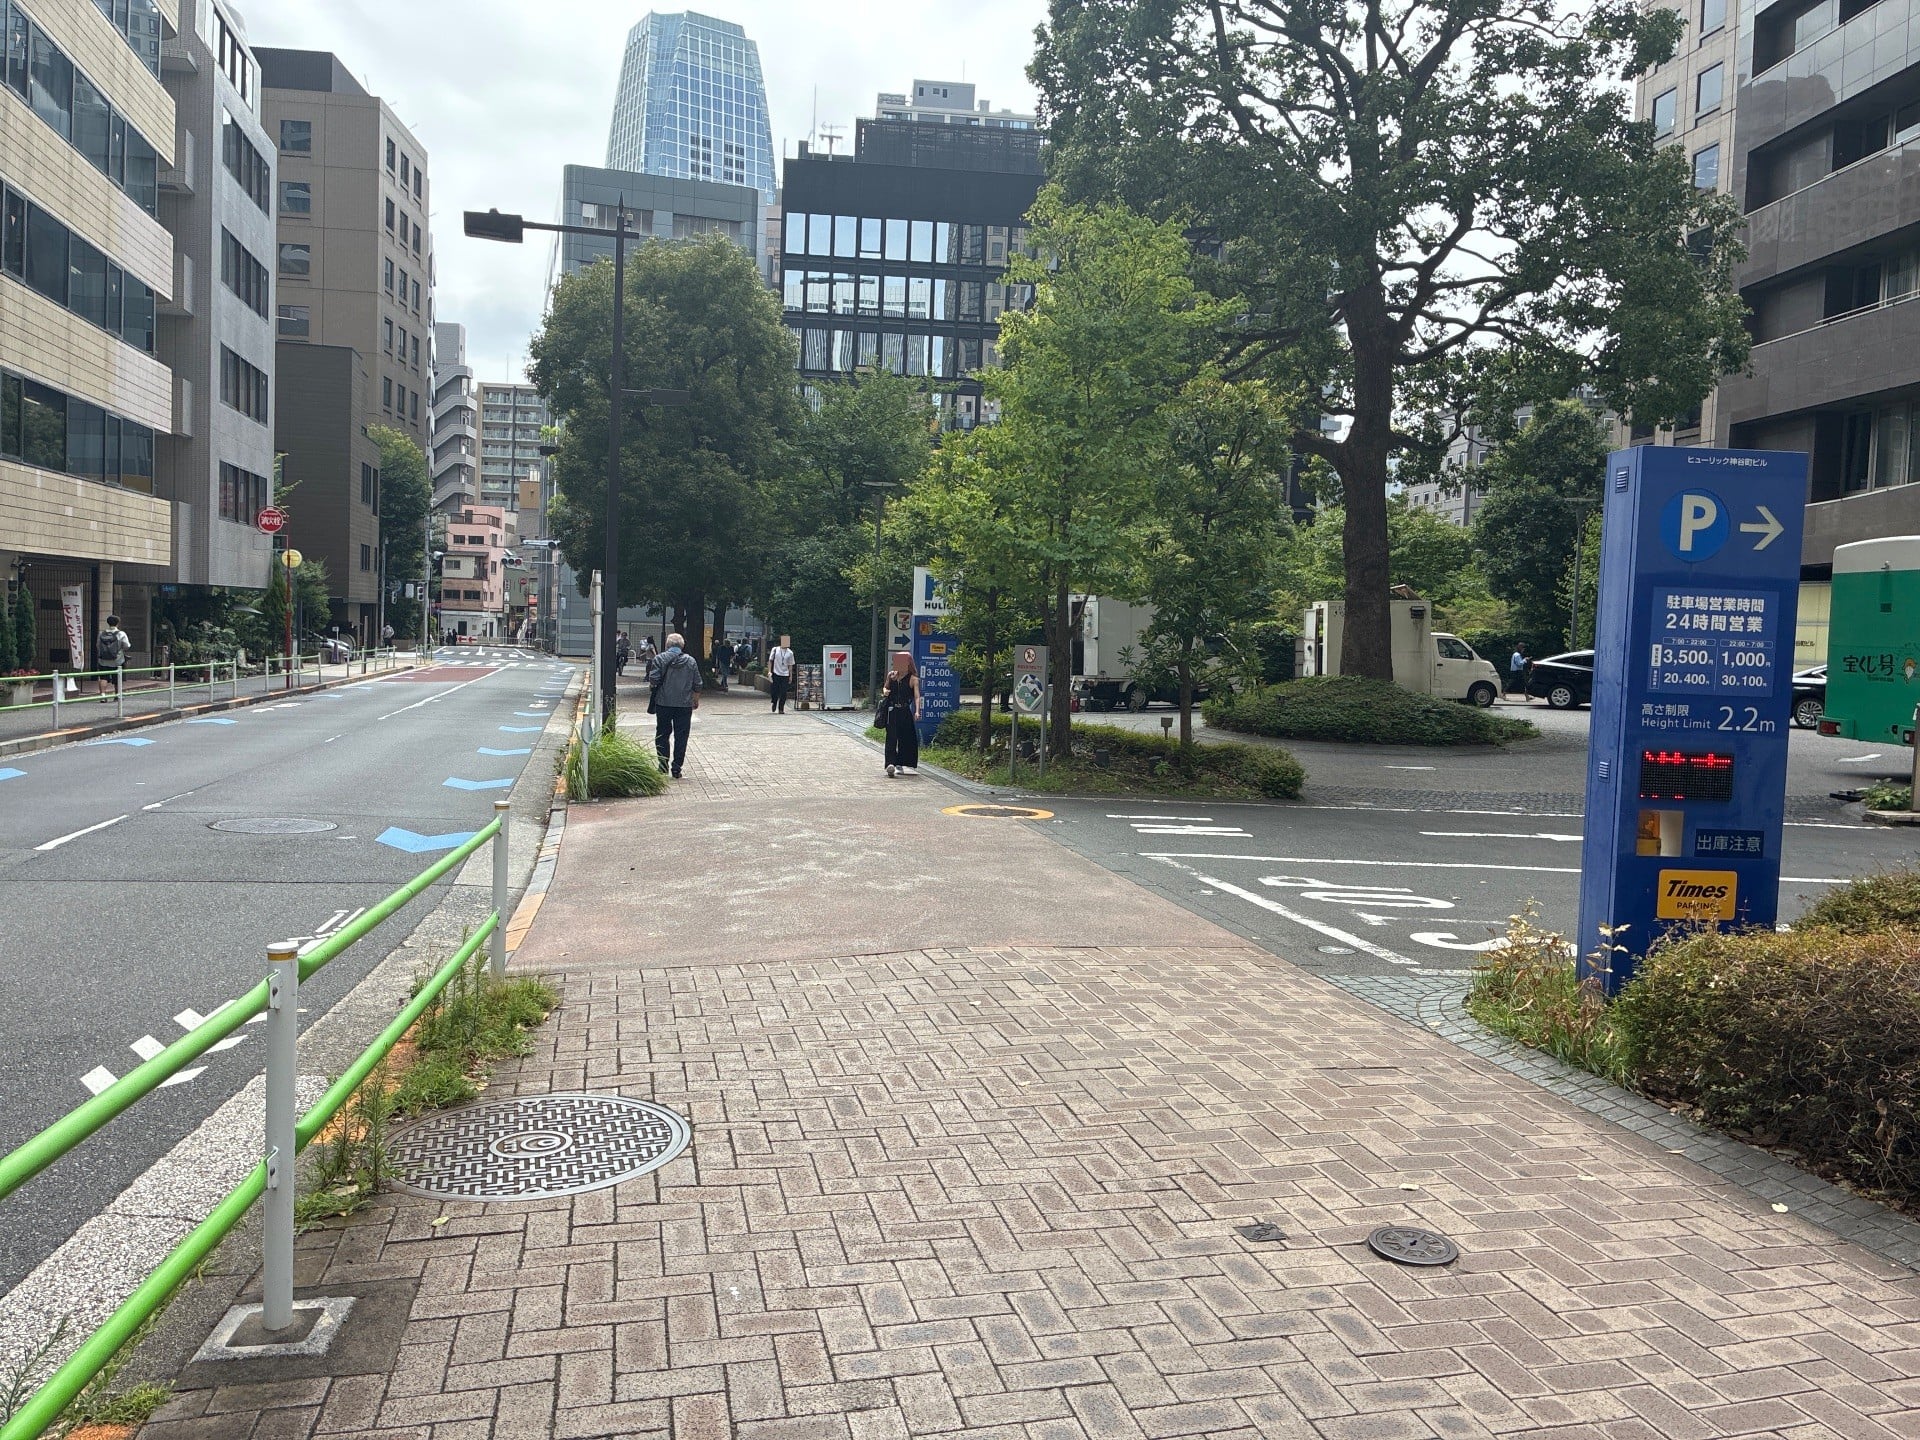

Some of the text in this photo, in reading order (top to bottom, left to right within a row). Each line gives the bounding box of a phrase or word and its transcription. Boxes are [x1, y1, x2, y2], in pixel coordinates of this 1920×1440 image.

[1687, 455, 1768, 467] ヒューリック神谷町ビル
[261, 517, 282, 526] 消火栓
[1680, 495, 1718, 552] P
[1666, 594, 1765, 613] 駐車場営業時間
[1665, 610, 1764, 633] 24時間営業
[1721, 651, 1771, 668] 1,000円
[1843, 653, 1896, 677] 宝くじ号
[1641, 703, 1690, 717] 高さ制限
[1717, 706, 1775, 732] 2.2m
[1641, 717, 1712, 731] Height Limit
[1696, 834, 1762, 853] 出庫注意
[1667, 880, 1729, 898] Times
